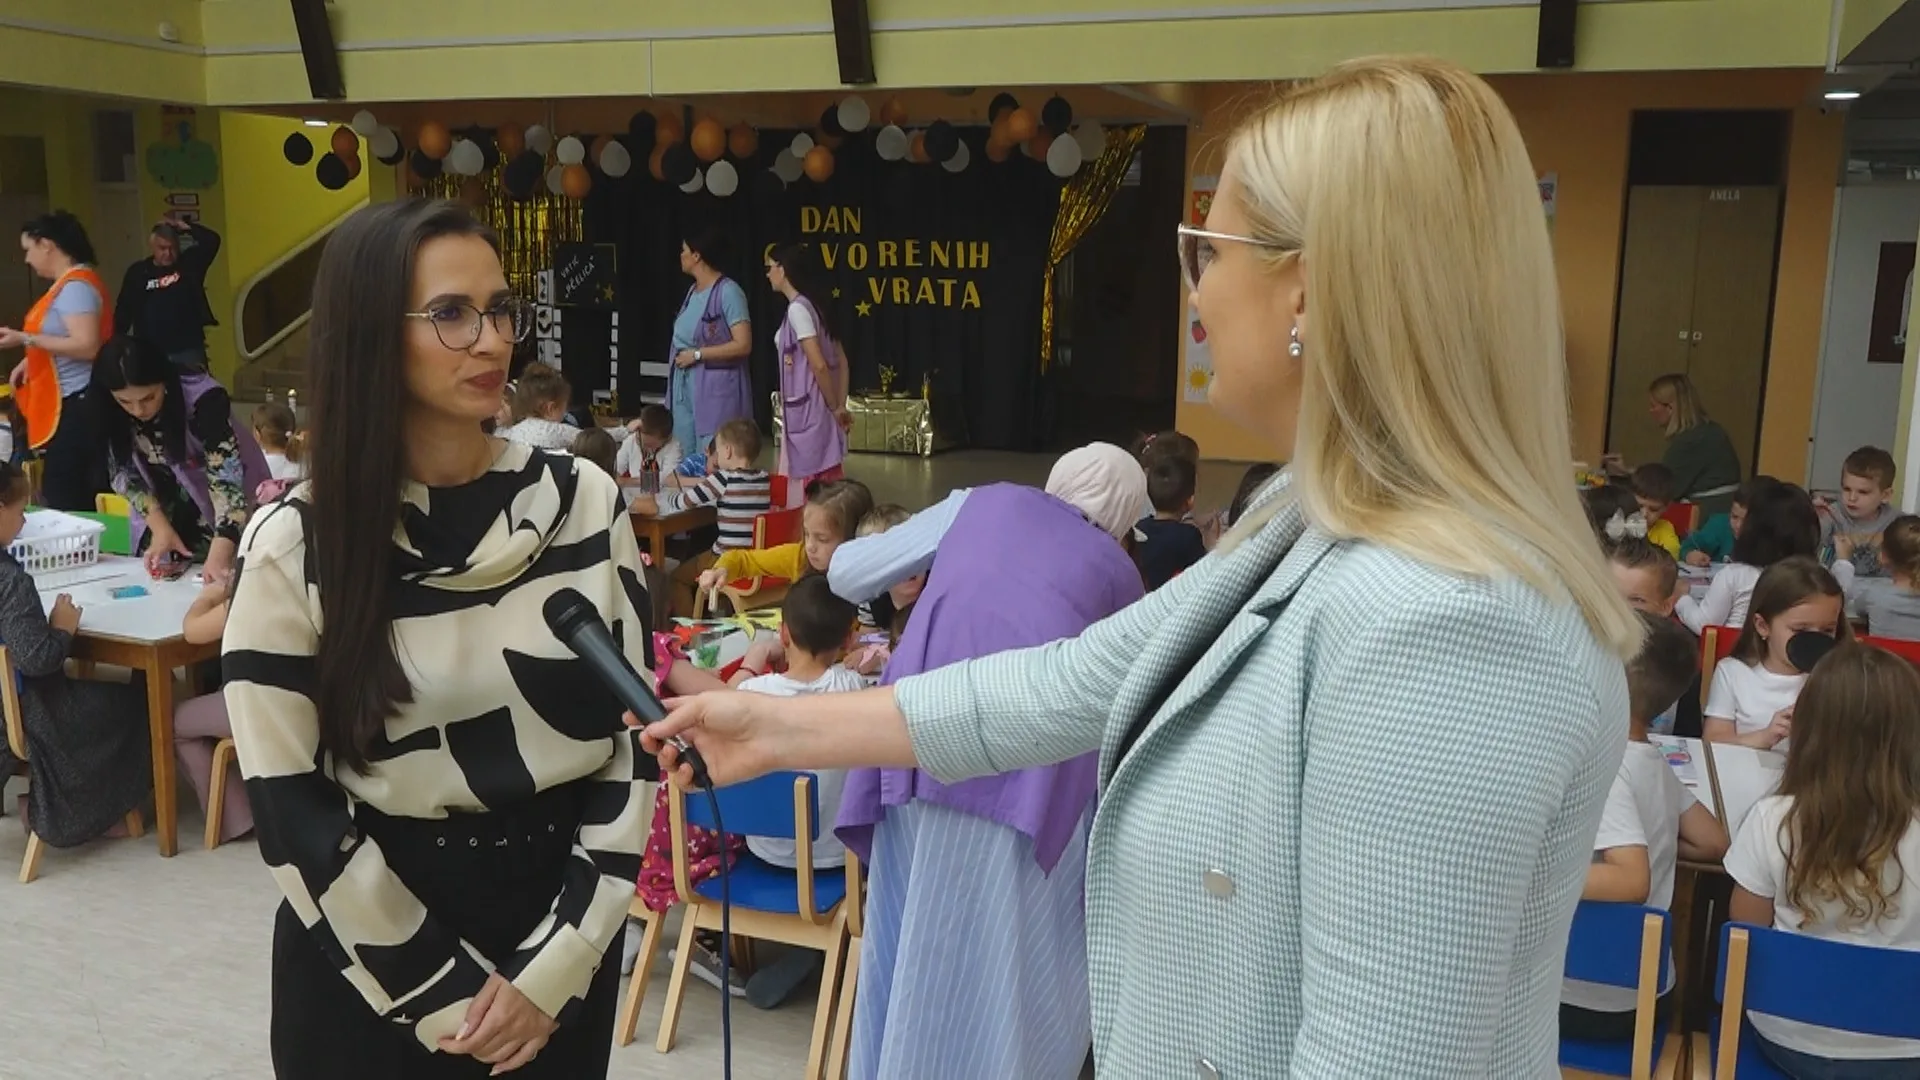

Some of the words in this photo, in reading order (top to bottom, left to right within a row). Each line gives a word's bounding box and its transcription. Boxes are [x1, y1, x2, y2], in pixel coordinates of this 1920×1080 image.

[801, 205, 862, 234] DAN
[764, 239, 989, 271] VORENIH
[868, 276, 981, 309] VRATA
